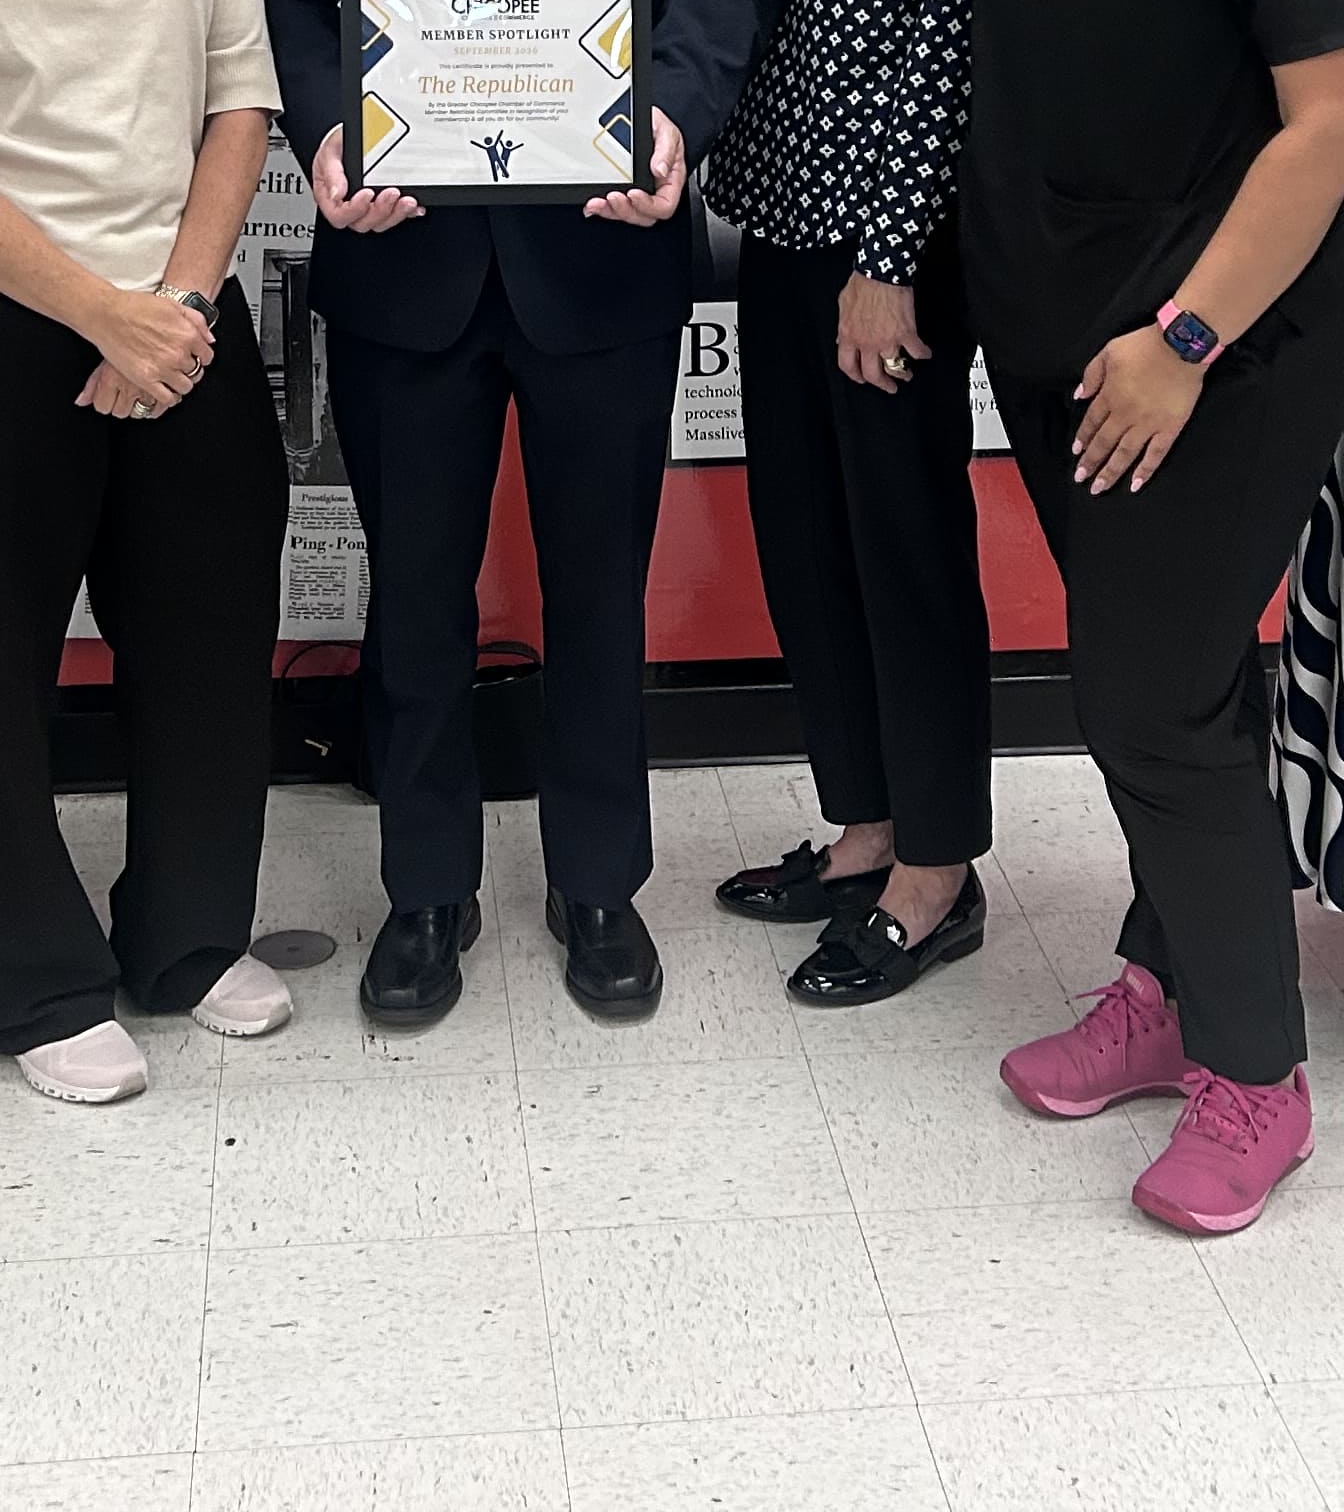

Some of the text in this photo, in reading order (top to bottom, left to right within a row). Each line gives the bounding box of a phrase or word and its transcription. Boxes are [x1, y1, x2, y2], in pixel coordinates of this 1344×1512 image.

[421, 28, 571, 41] MEMBER SPOTLIGHT
[453, 46, 512, 56] SEPTEMBER
[417, 74, 575, 100] The Republican
[684, 408, 738, 424] process
[290, 534, 327, 554] Ping
